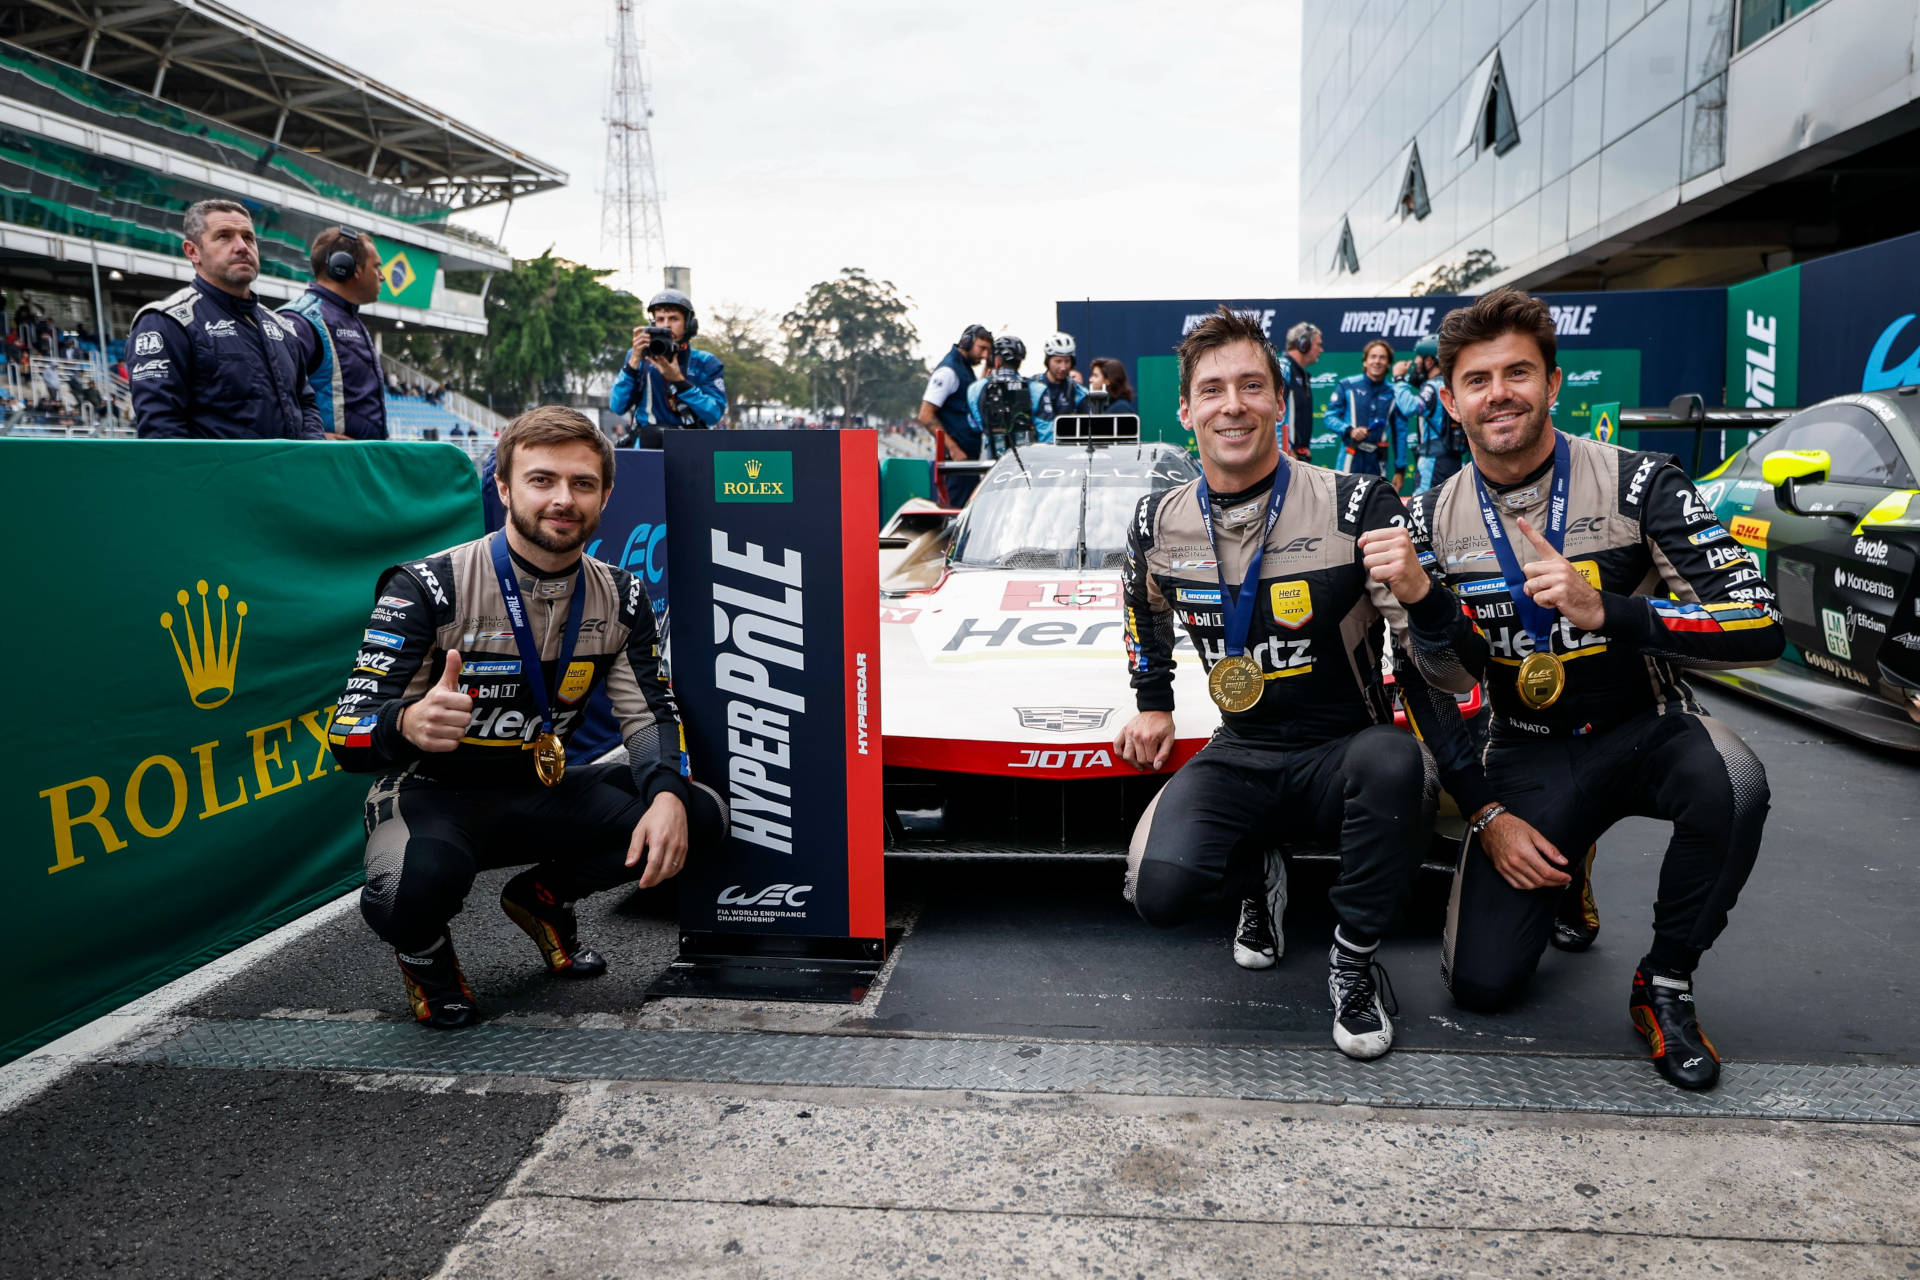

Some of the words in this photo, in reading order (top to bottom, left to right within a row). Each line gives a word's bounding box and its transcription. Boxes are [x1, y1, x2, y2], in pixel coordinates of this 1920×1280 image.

[135, 332, 164, 354] FIA
[133, 360, 171, 373] WEC
[993, 467, 1189, 484] CADILLAC
[1625, 456, 1656, 505] HRX
[723, 482, 784, 495] ROLEX
[1344, 476, 1371, 523] HRX
[1139, 496, 1150, 536] HRX
[1736, 524, 1761, 540] DHL
[413, 563, 449, 606] HRX
[1028, 583, 1118, 608] 12
[1279, 589, 1301, 599] Hertz
[1467, 581, 1506, 592] MICHELIN
[1847, 572, 1894, 599] Koncentra
[1180, 609, 1212, 626] Mobil
[1826, 613, 1842, 634] LM
[1857, 612, 1887, 634] Eficium
[1828, 633, 1848, 656] GT3
[476, 664, 516, 672] MICHELIN
[1805, 650, 1870, 686] GOODYEAR
[857, 653, 868, 755] HYPERCAR
[1509, 717, 1550, 735] N.NATO
[1008, 750, 1112, 768] JOTA
[39, 704, 345, 874] ROLEX
[717, 883, 813, 907] WEC
